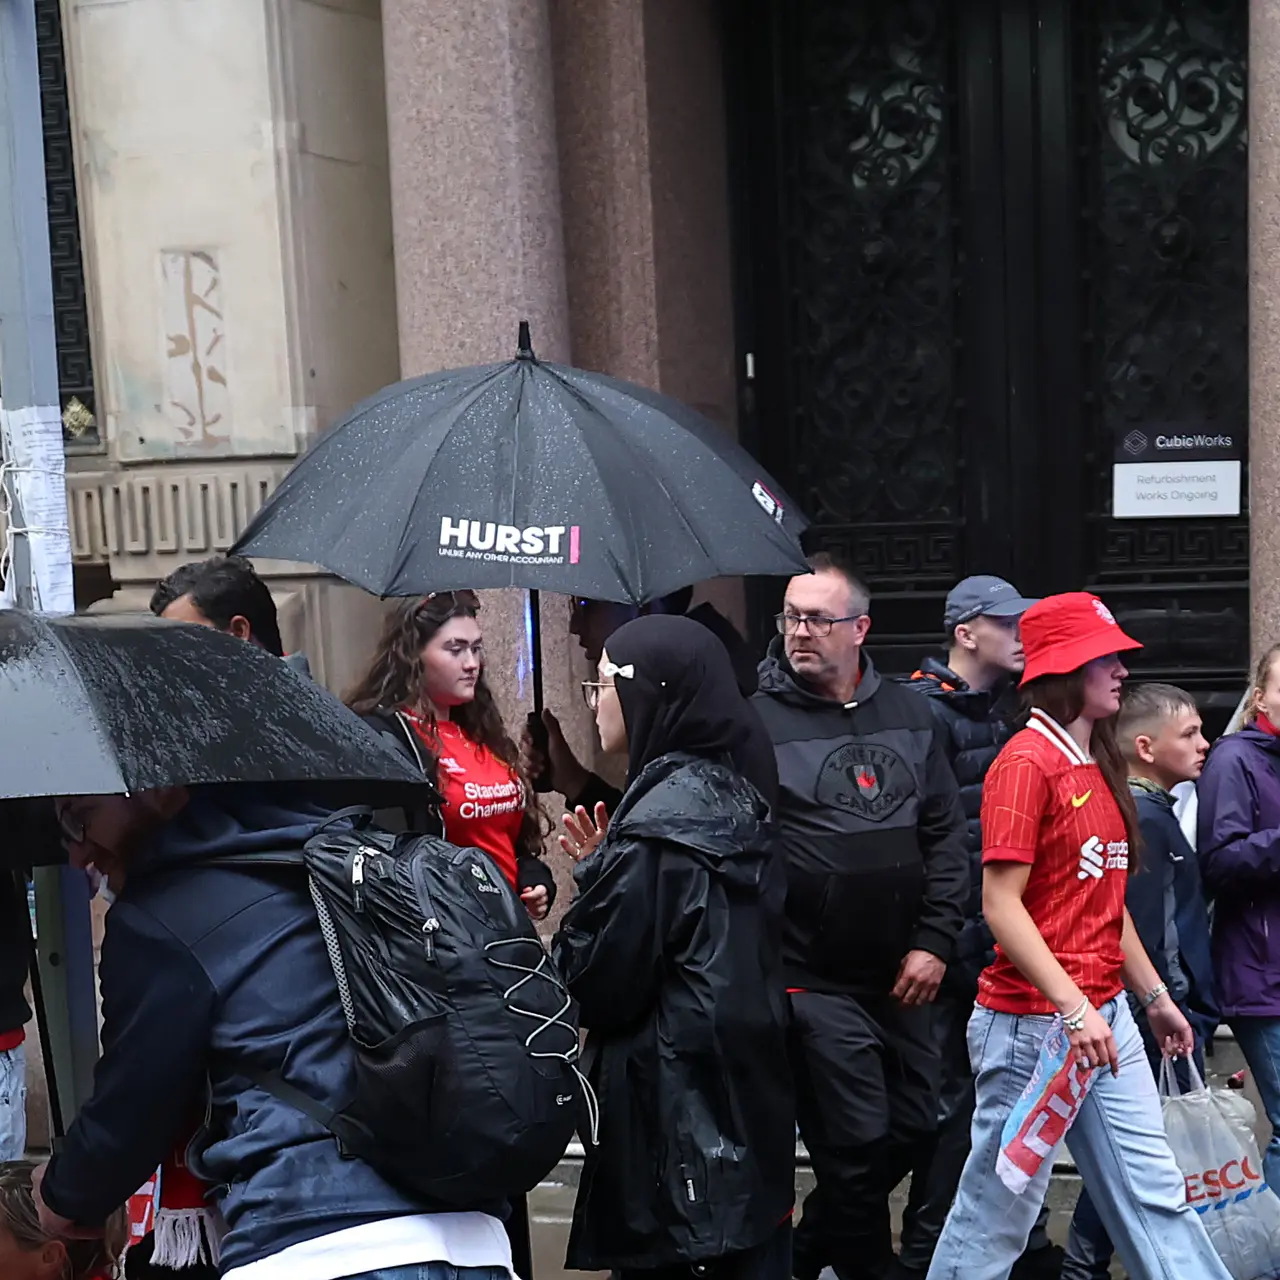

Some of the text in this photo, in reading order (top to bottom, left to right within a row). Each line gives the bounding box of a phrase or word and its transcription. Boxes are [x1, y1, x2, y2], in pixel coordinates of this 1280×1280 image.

[1156, 434, 1232, 448] CubicWorks
[1137, 474, 1217, 485] Refurbishment
[1135, 489, 1218, 502] Works Ongoing
[440, 516, 565, 554] HURST
[438, 548, 564, 564] UNLIKE ANY OTHER ACCOUNTANT
[464, 780, 518, 800] Standard
